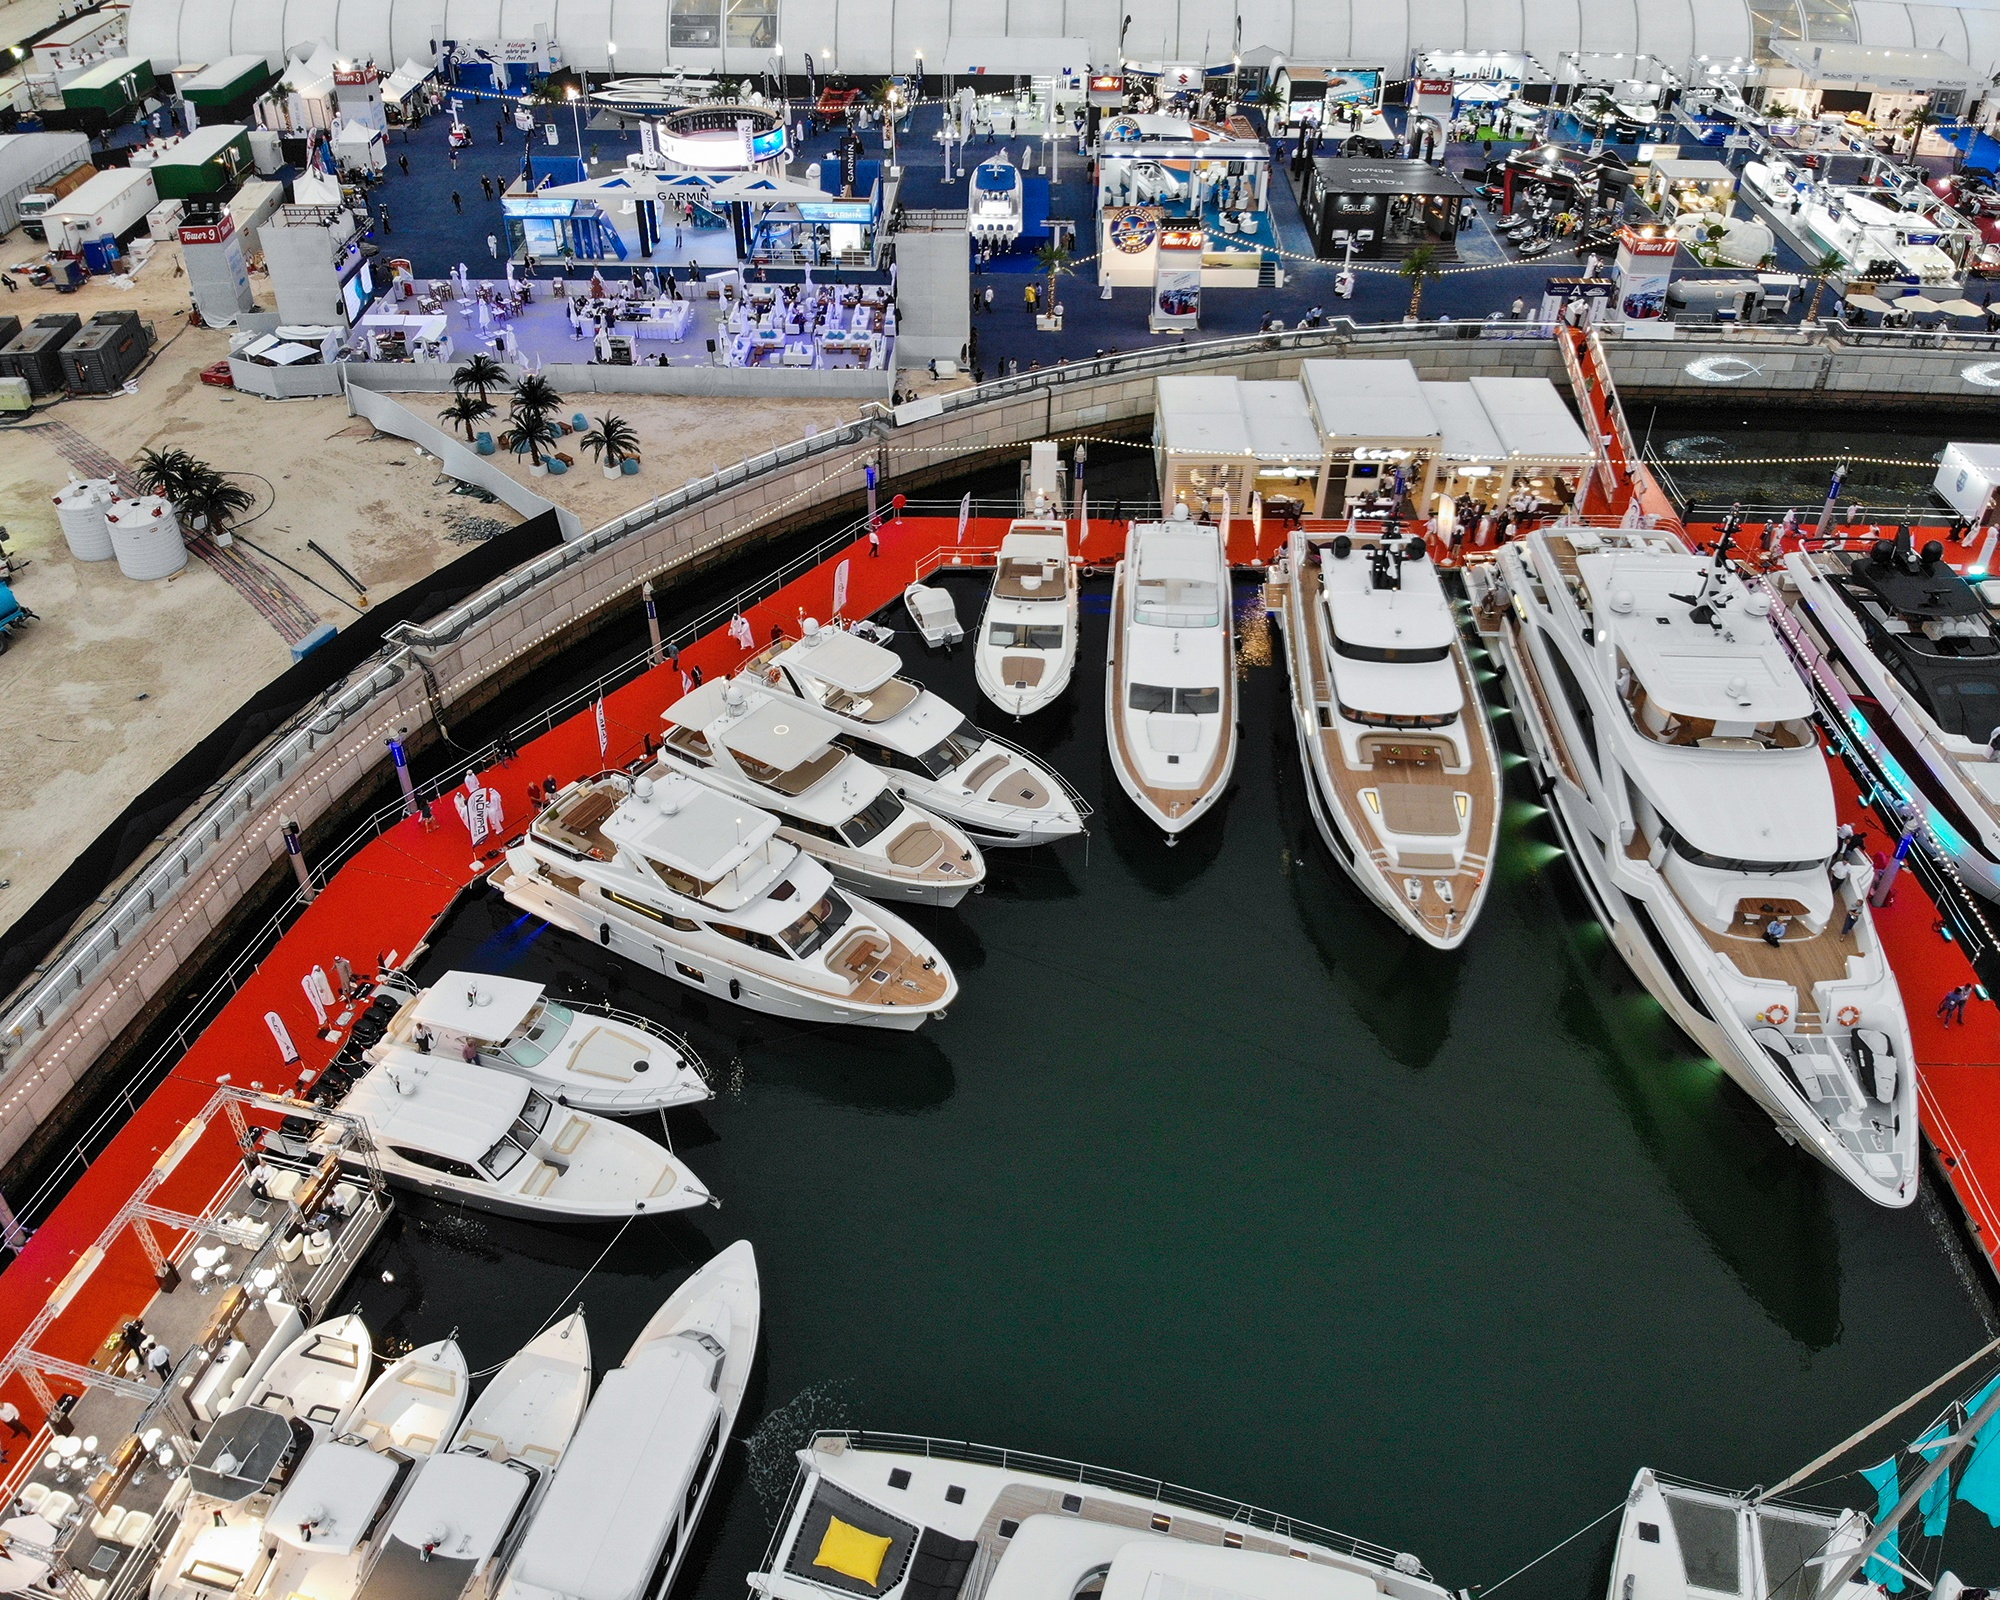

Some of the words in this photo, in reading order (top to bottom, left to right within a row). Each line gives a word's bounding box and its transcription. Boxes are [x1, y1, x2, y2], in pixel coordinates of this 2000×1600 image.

[355, 73, 361, 83] 3
[1442, 82, 1451, 93] 5
[847, 143, 855, 182] GARMIN
[657, 191, 710, 201] GARMIN
[532, 206, 569, 214] GARMIN
[1342, 203, 1371, 212] FOILER
[827, 211, 862, 219] GARMIN
[181, 231, 207, 242] Tower
[208, 229, 216, 241] 9
[1162, 234, 1188, 246] Tower
[1187, 233, 1201, 247] 10
[1637, 241, 1662, 252] Tower
[1662, 241, 1676, 253] 11
[1570, 285, 1581, 296] A
